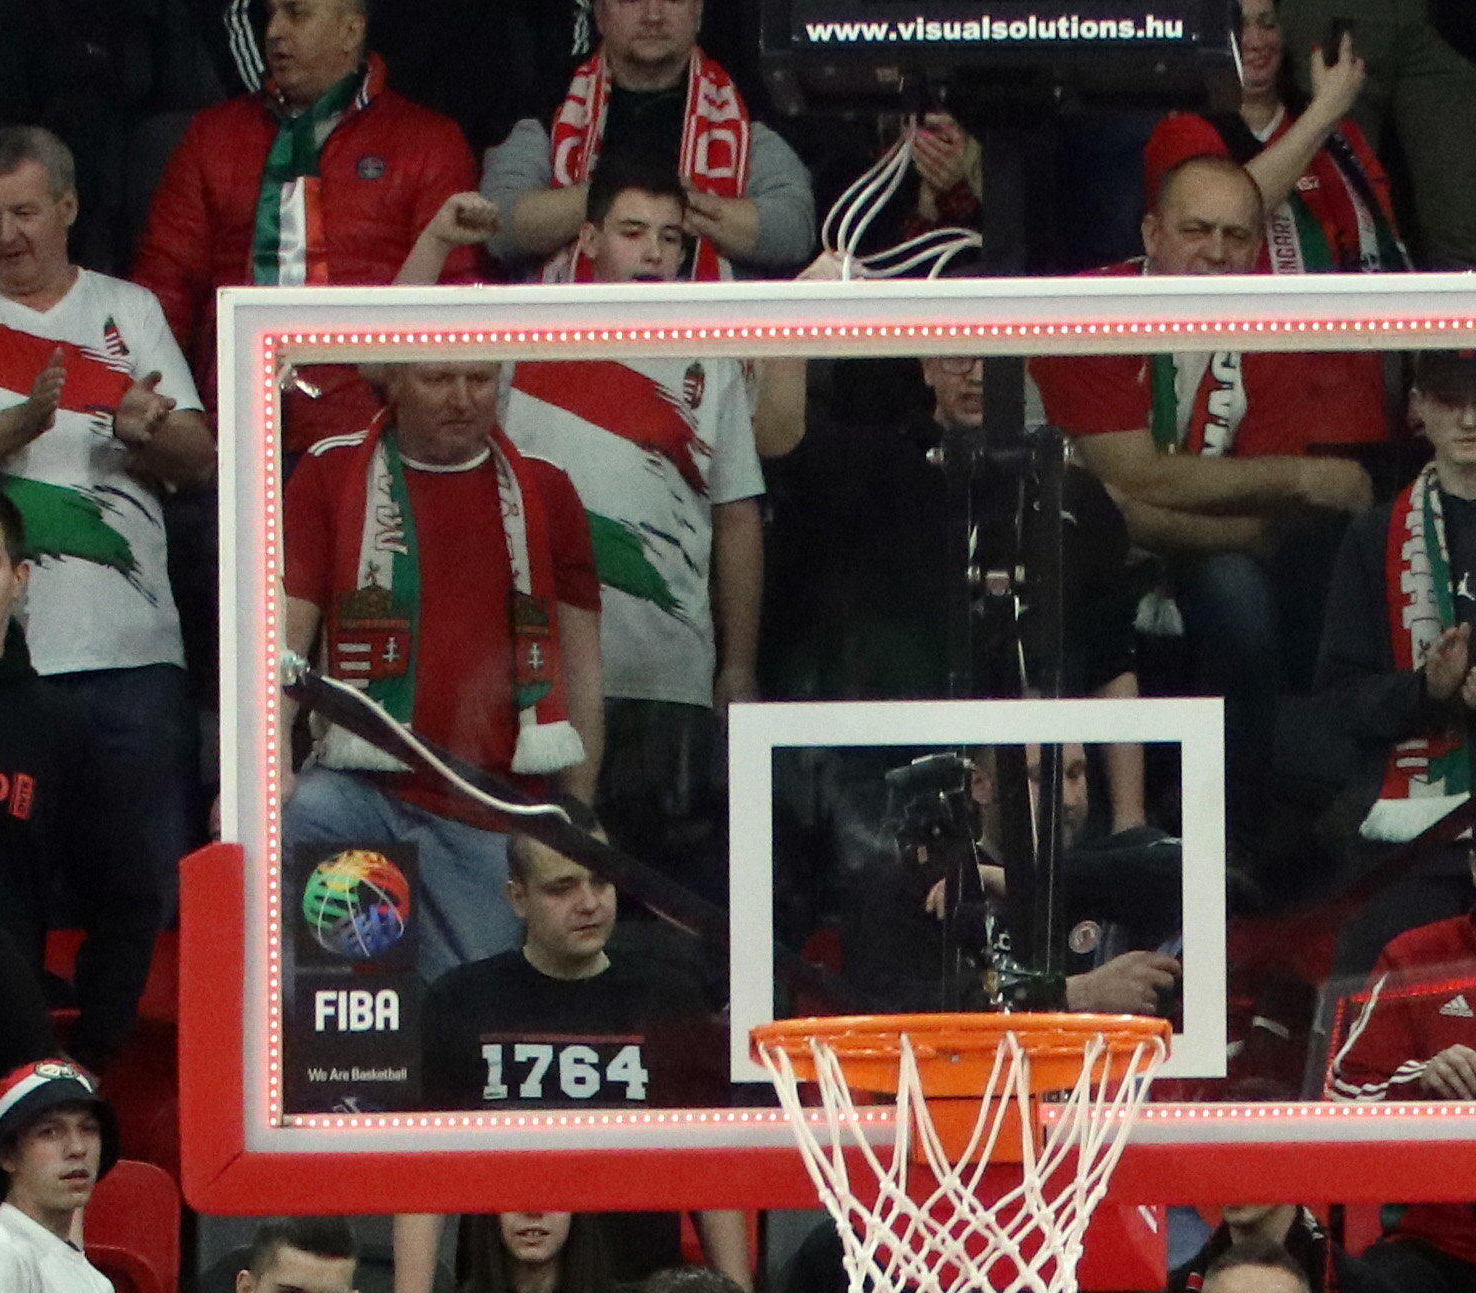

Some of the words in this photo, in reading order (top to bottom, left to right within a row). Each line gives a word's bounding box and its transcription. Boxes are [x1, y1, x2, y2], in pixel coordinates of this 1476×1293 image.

[804, 16, 1187, 45] www.visualsolutions.hu
[314, 989, 401, 1032] FIBA
[307, 1067, 328, 1082] We
[329, 1067, 350, 1081] Are
[351, 1066, 408, 1082] Basketball
[481, 1043, 650, 1100] 1764
